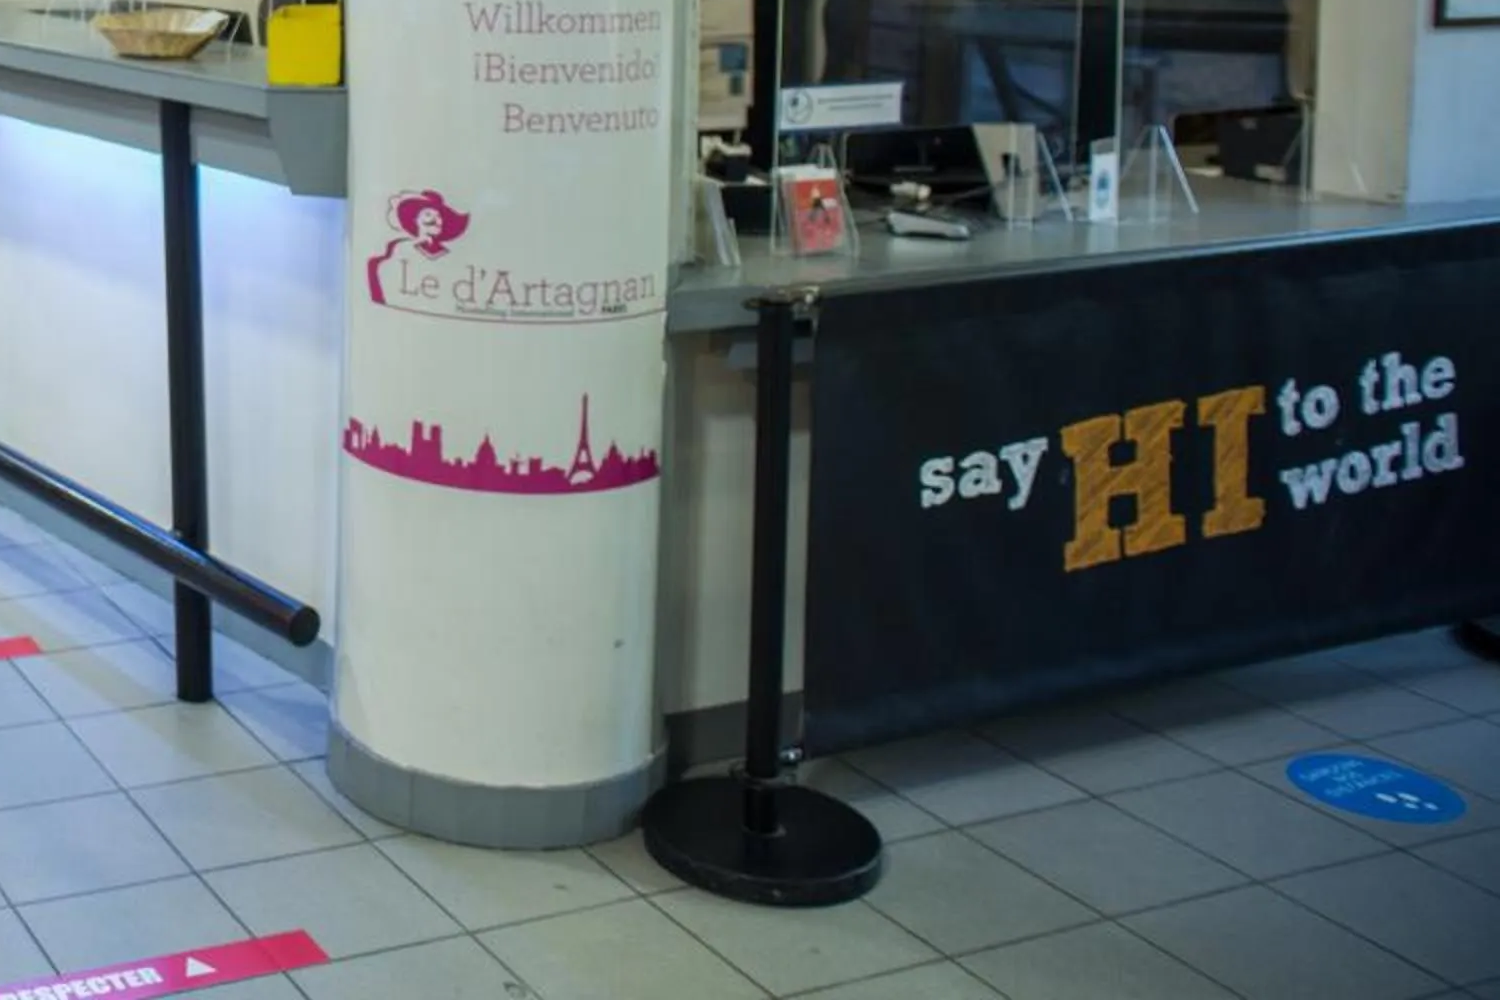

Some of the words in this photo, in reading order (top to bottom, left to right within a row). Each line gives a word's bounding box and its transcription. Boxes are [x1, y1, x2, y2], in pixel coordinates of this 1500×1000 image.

[463, 0, 662, 35] Willkommen
[503, 102, 659, 135] Benvenuto
[398, 258, 441, 299] Le
[452, 264, 657, 316] d'Artagnan
[919, 437, 1048, 510] say
[1061, 385, 1267, 573] HI
[1277, 377, 1339, 436] to
[1358, 351, 1456, 415] the
[1281, 413, 1465, 510] world
